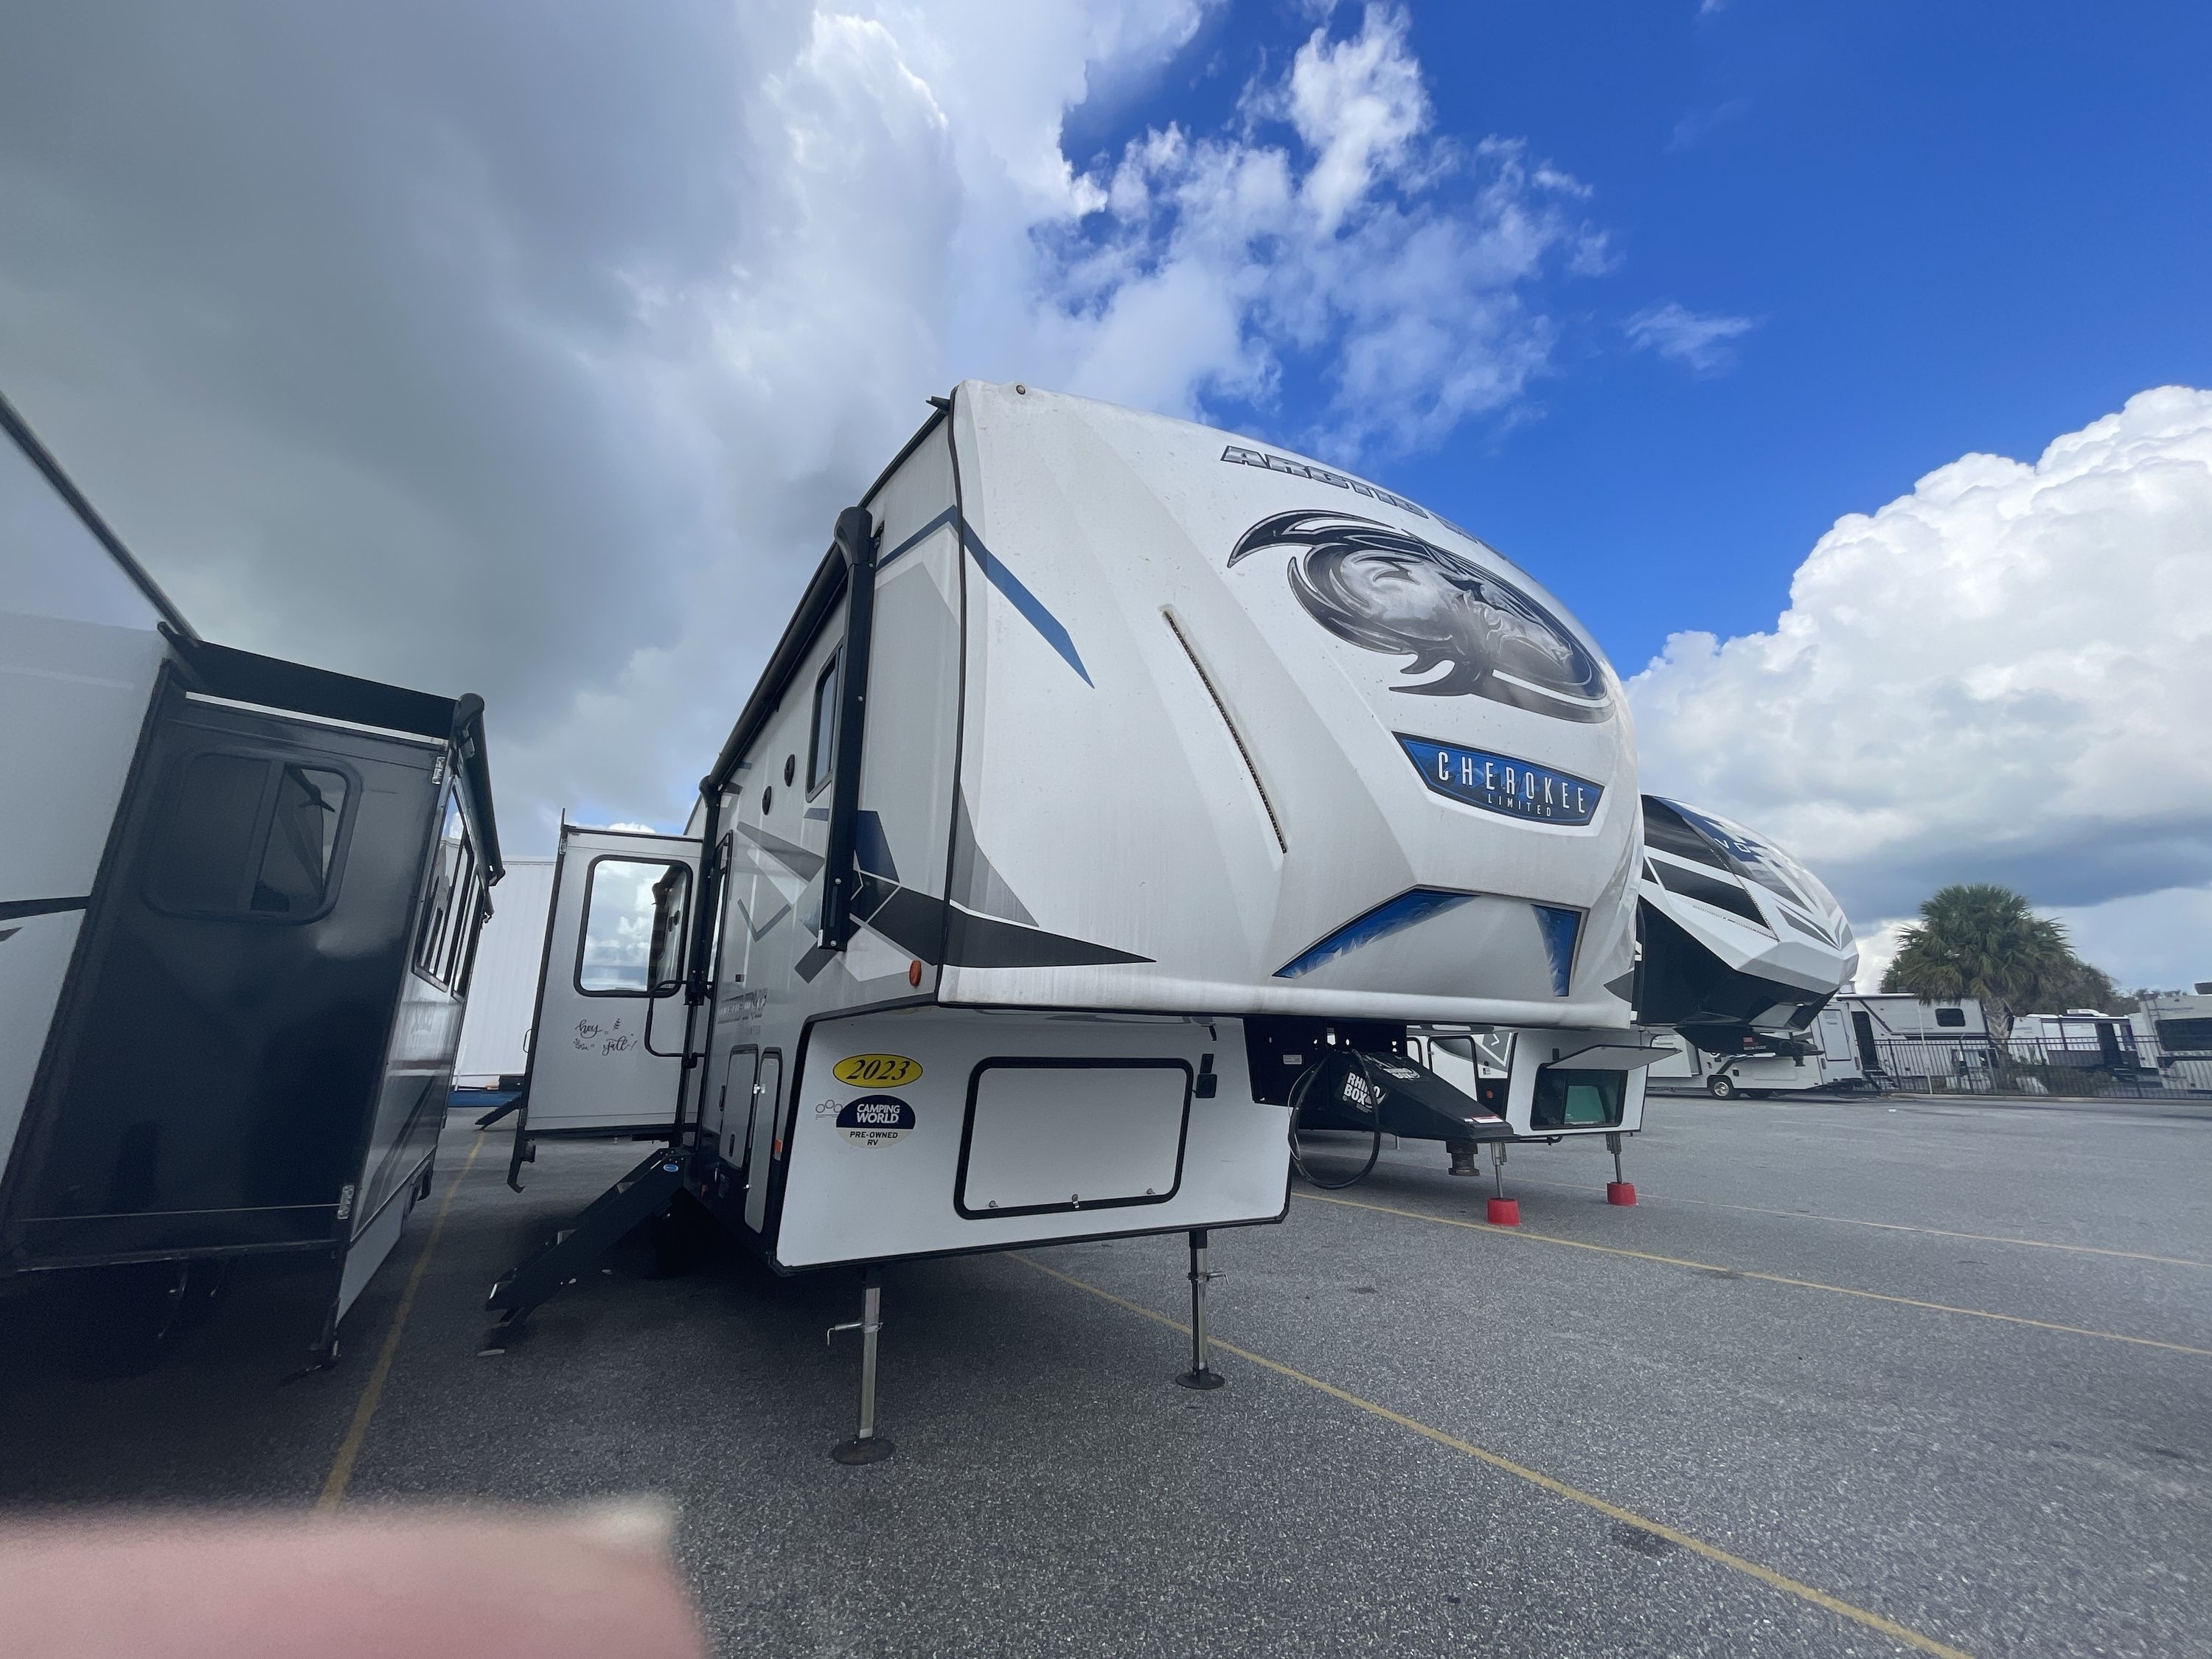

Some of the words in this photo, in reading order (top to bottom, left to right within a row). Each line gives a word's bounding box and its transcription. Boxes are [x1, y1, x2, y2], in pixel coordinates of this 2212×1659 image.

[1438, 751, 1585, 813] CHEROKEE
[1488, 793, 1551, 817] LIMITED
[575, 1019, 602, 1039] hey
[846, 1059, 911, 1080] 2023
[1343, 1083, 1368, 1106] BOX
[856, 1103, 900, 1114] CAMPING
[856, 1112, 899, 1124] WORLD
